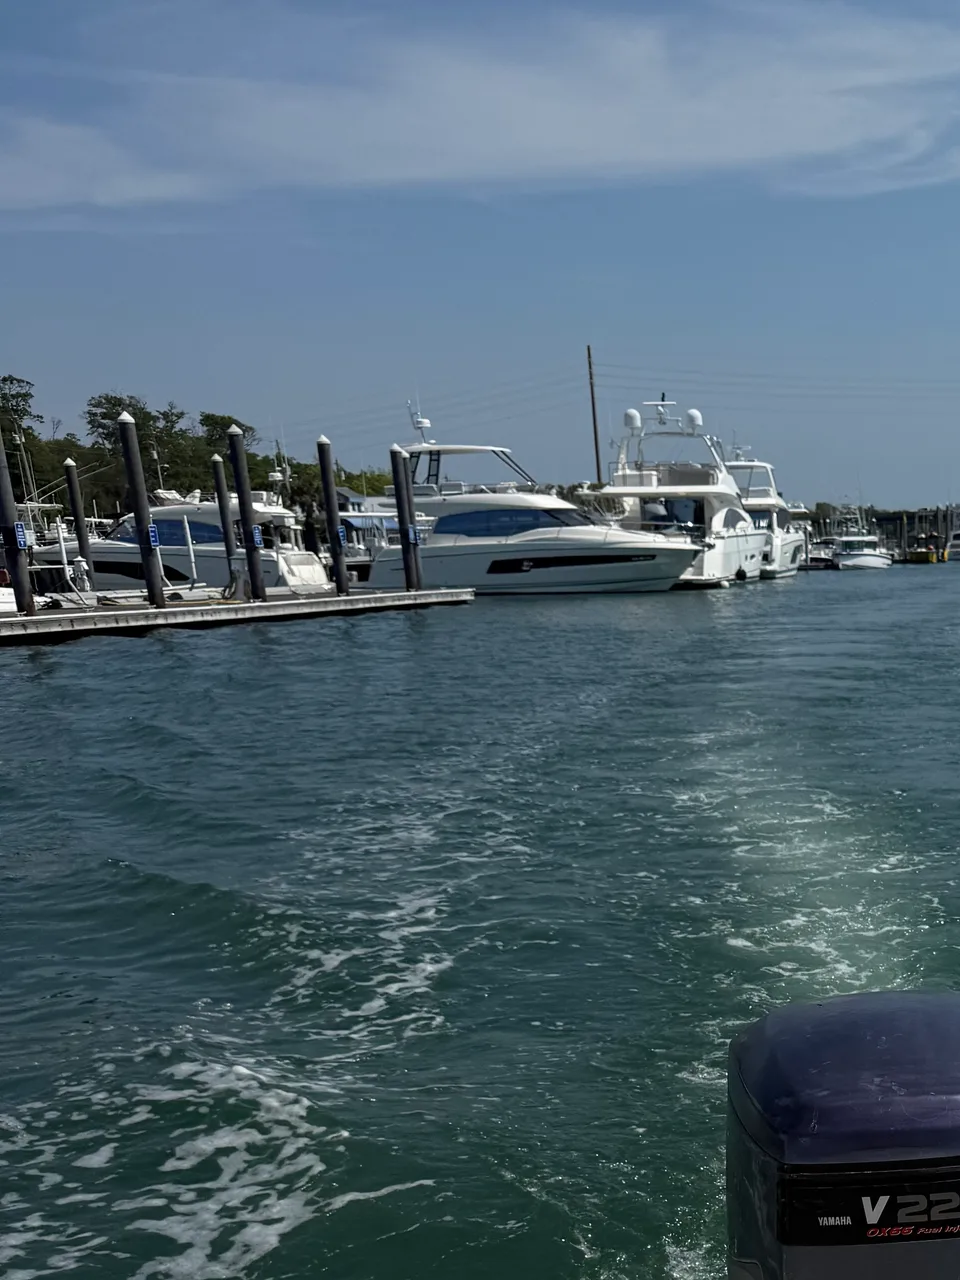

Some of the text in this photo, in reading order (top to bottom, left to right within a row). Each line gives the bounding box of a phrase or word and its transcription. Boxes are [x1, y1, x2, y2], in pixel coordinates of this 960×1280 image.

[818, 1216, 852, 1226] YAMAHA
[866, 1226, 915, 1238] OX66
[916, 1226, 942, 1235] Fuel
